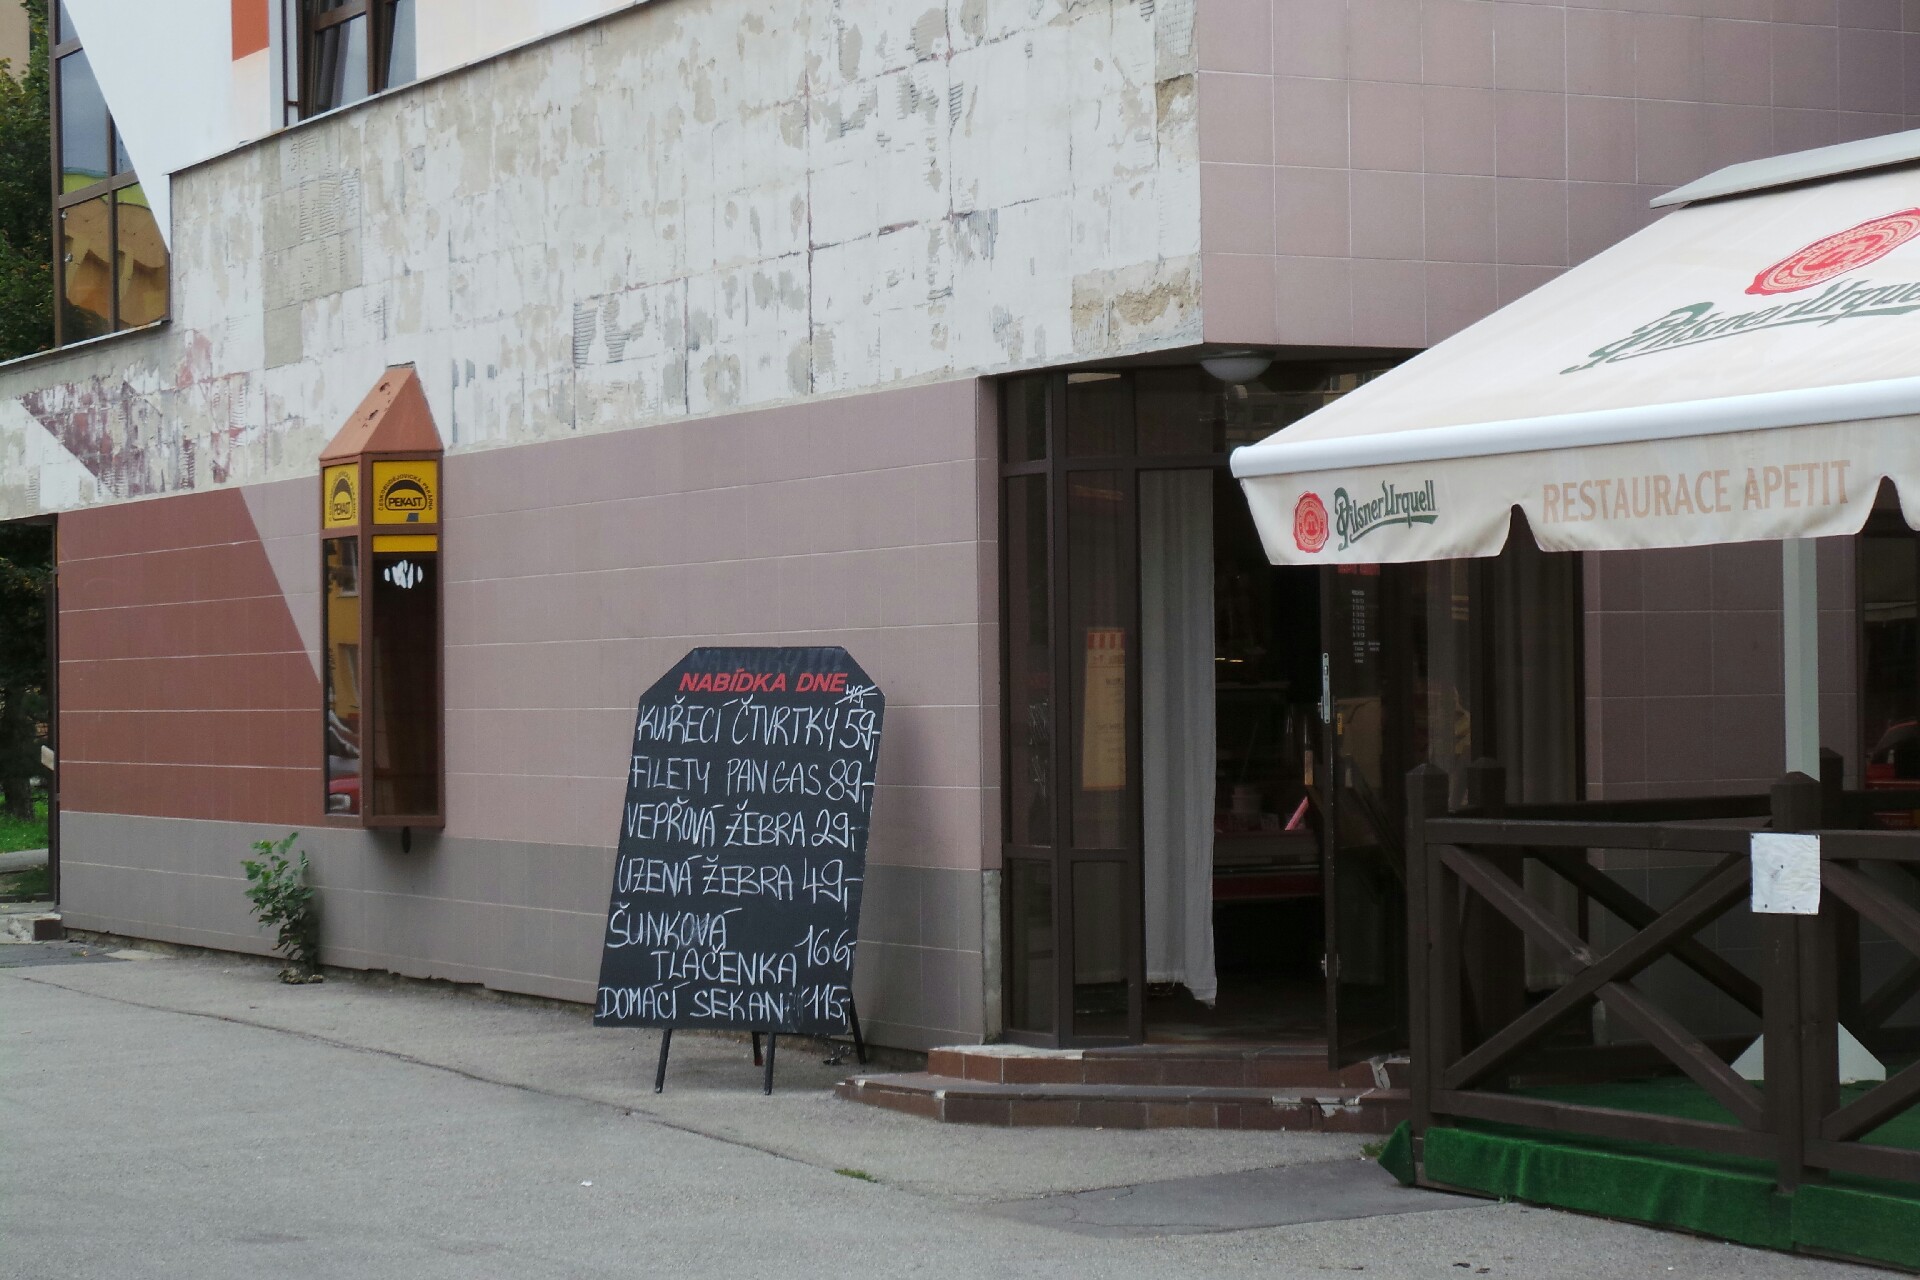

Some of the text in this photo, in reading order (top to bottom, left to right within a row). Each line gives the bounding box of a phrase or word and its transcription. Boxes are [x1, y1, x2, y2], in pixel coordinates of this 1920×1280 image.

[388, 496, 422, 508] PEKAST
[1334, 487, 1384, 551] Pilsner
[1381, 479, 1437, 529] Urquell
[1542, 459, 1851, 524] RESTAURACE APETIT
[678, 667, 848, 692] NABÍDKA DNE
[637, 694, 738, 745] KUŘECÍ
[732, 694, 839, 751] ČTVRTKY
[632, 755, 711, 794] FILETY
[627, 796, 724, 848] VEPŘOVÁ
[724, 799, 806, 848] ŽEBRA
[618, 855, 703, 898] UZENÁ
[701, 854, 794, 901] ŽEBRA
[606, 900, 743, 949] ŠUNKOVÁ
[650, 944, 797, 988] TLAČENKA
[594, 981, 691, 1020] DOMÁCÍ
[690, 987, 803, 1024] SEKAN
